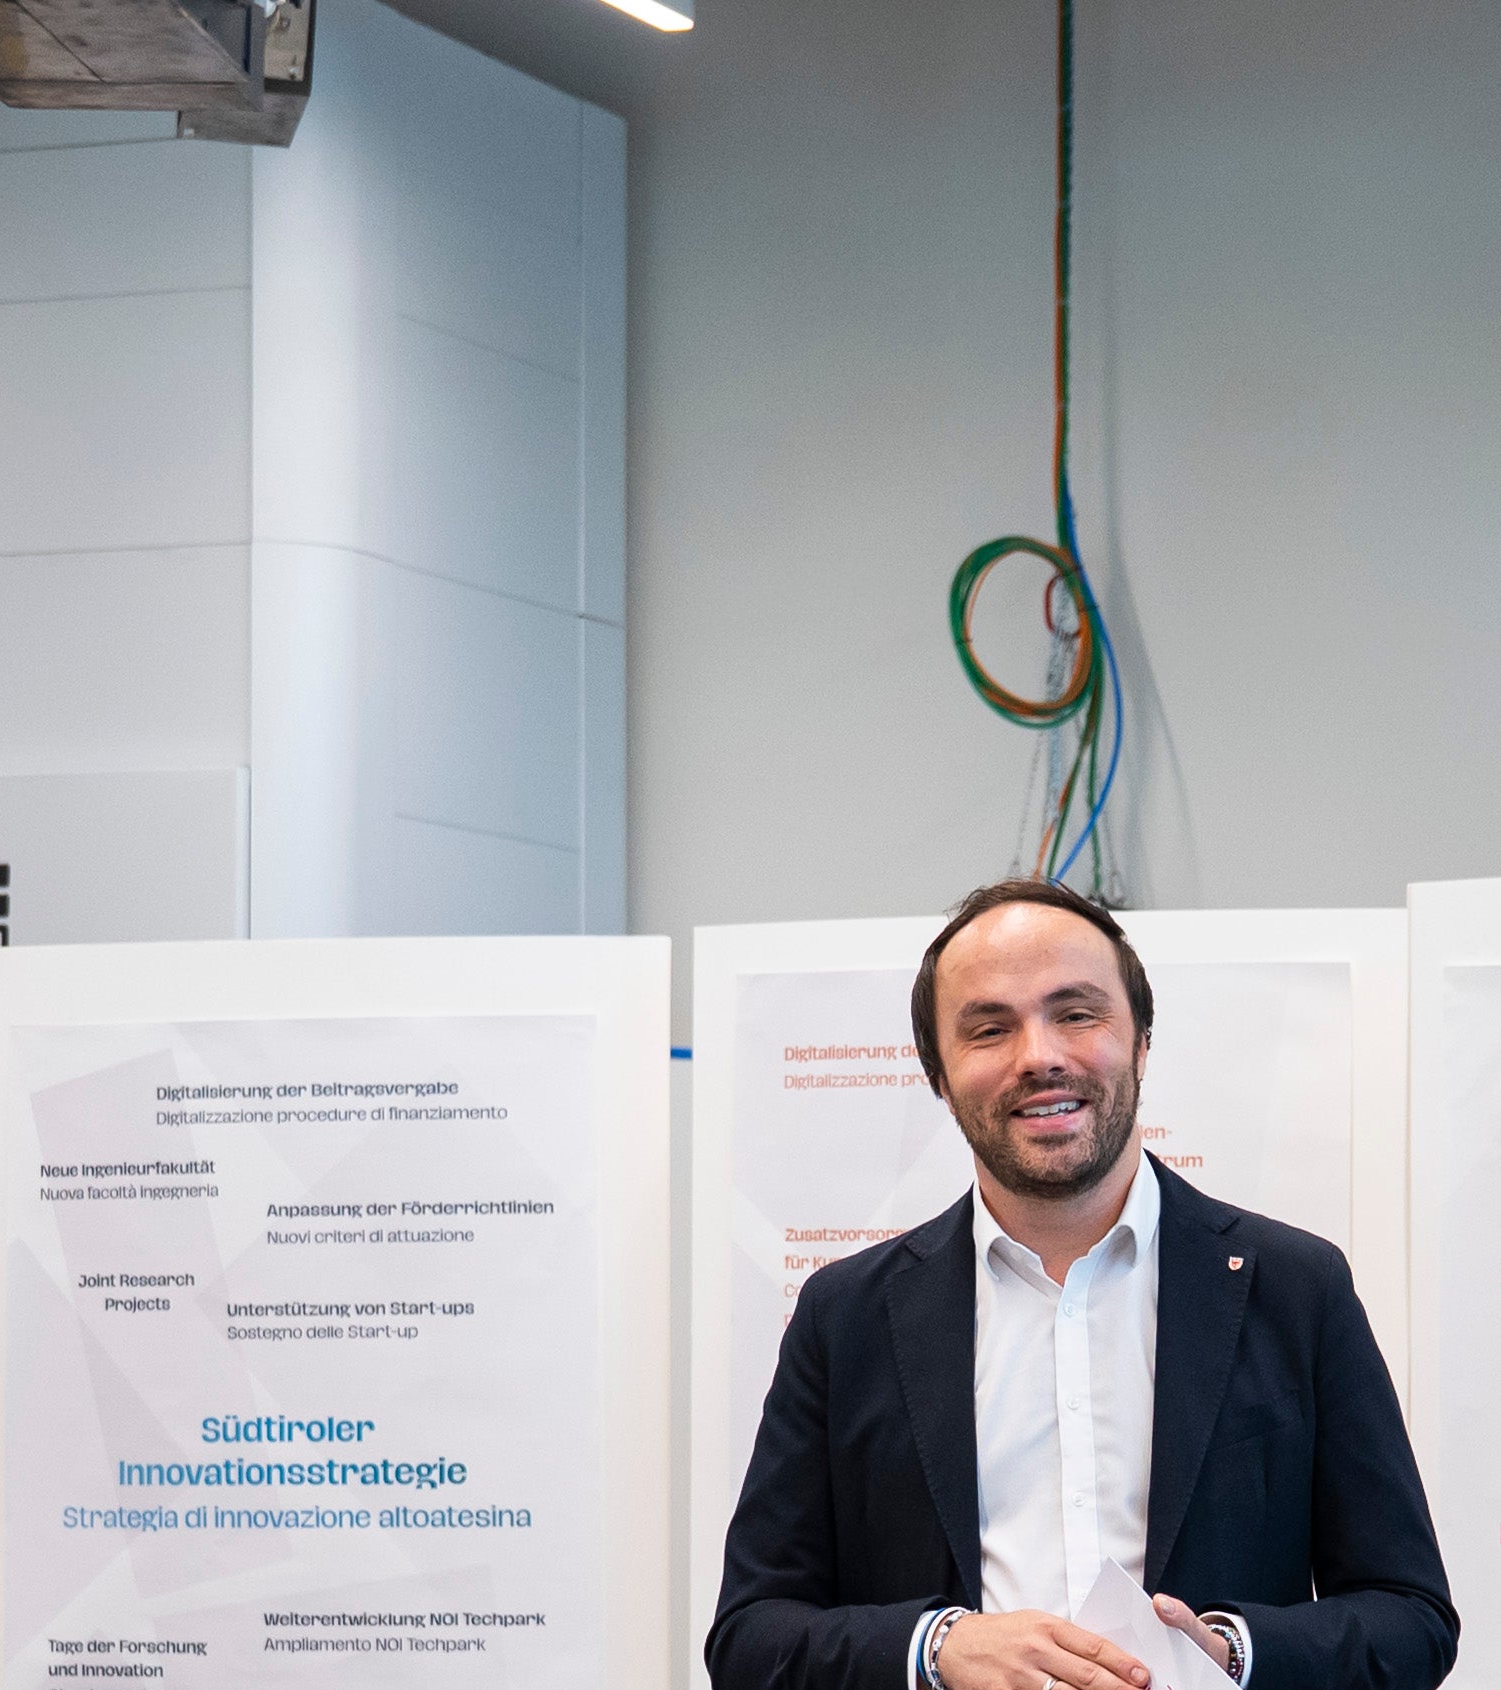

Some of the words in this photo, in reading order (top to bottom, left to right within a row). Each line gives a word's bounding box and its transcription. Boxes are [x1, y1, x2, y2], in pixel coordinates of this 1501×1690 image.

[784, 1045, 898, 1063] Digitalisierung
[784, 1073, 898, 1090] Digitalizzazione
[155, 1084, 274, 1103] Digitalisierung
[275, 1083, 308, 1098] der
[310, 1081, 459, 1099] Beitragsvergabe
[155, 1108, 274, 1128] Digitalizzazione
[276, 1107, 368, 1125] procedure
[369, 1106, 386, 1122] di
[388, 1105, 508, 1121] finanziamento
[40, 1164, 79, 1178] Neue
[81, 1159, 216, 1179] Ingenieurfakultät
[39, 1187, 85, 1202] Nuova
[86, 1183, 138, 1200] facoltà
[139, 1183, 219, 1201] ingegneria
[266, 1203, 364, 1219] Anpassung
[365, 1202, 398, 1217] der
[401, 1199, 555, 1216] Förderrichtlinien
[266, 1229, 312, 1245] Nuovi
[313, 1228, 366, 1244] criteri
[368, 1228, 384, 1244] di
[386, 1228, 475, 1244] attuazione
[785, 1255, 809, 1269] für
[77, 1273, 116, 1289] Joint
[119, 1273, 196, 1288] Research
[104, 1296, 171, 1314] Projects
[226, 1301, 352, 1319] Unterstützung
[353, 1303, 387, 1316] von
[389, 1301, 475, 1317] Start-ups
[226, 1325, 303, 1342] Sostegno
[305, 1325, 345, 1340] delle
[347, 1324, 419, 1340] Start-up
[201, 1414, 376, 1444] Südtiroler
[119, 1456, 468, 1490] Innovationsstrategie
[62, 1505, 179, 1532] Strategia
[184, 1505, 208, 1529] di
[213, 1505, 372, 1529] innovazione
[378, 1504, 532, 1529] altoatesina
[263, 1611, 427, 1629] Weiterentwicklung
[429, 1612, 459, 1627] NOI
[462, 1612, 546, 1628] Techpark
[47, 1638, 84, 1656] Tage
[86, 1639, 116, 1654] der
[119, 1639, 208, 1657] Forschung
[263, 1636, 372, 1654] Ampliamento
[375, 1637, 403, 1652] NOI
[406, 1637, 487, 1654] Techpark
[47, 1663, 79, 1677] und
[81, 1663, 164, 1678] Innovation
